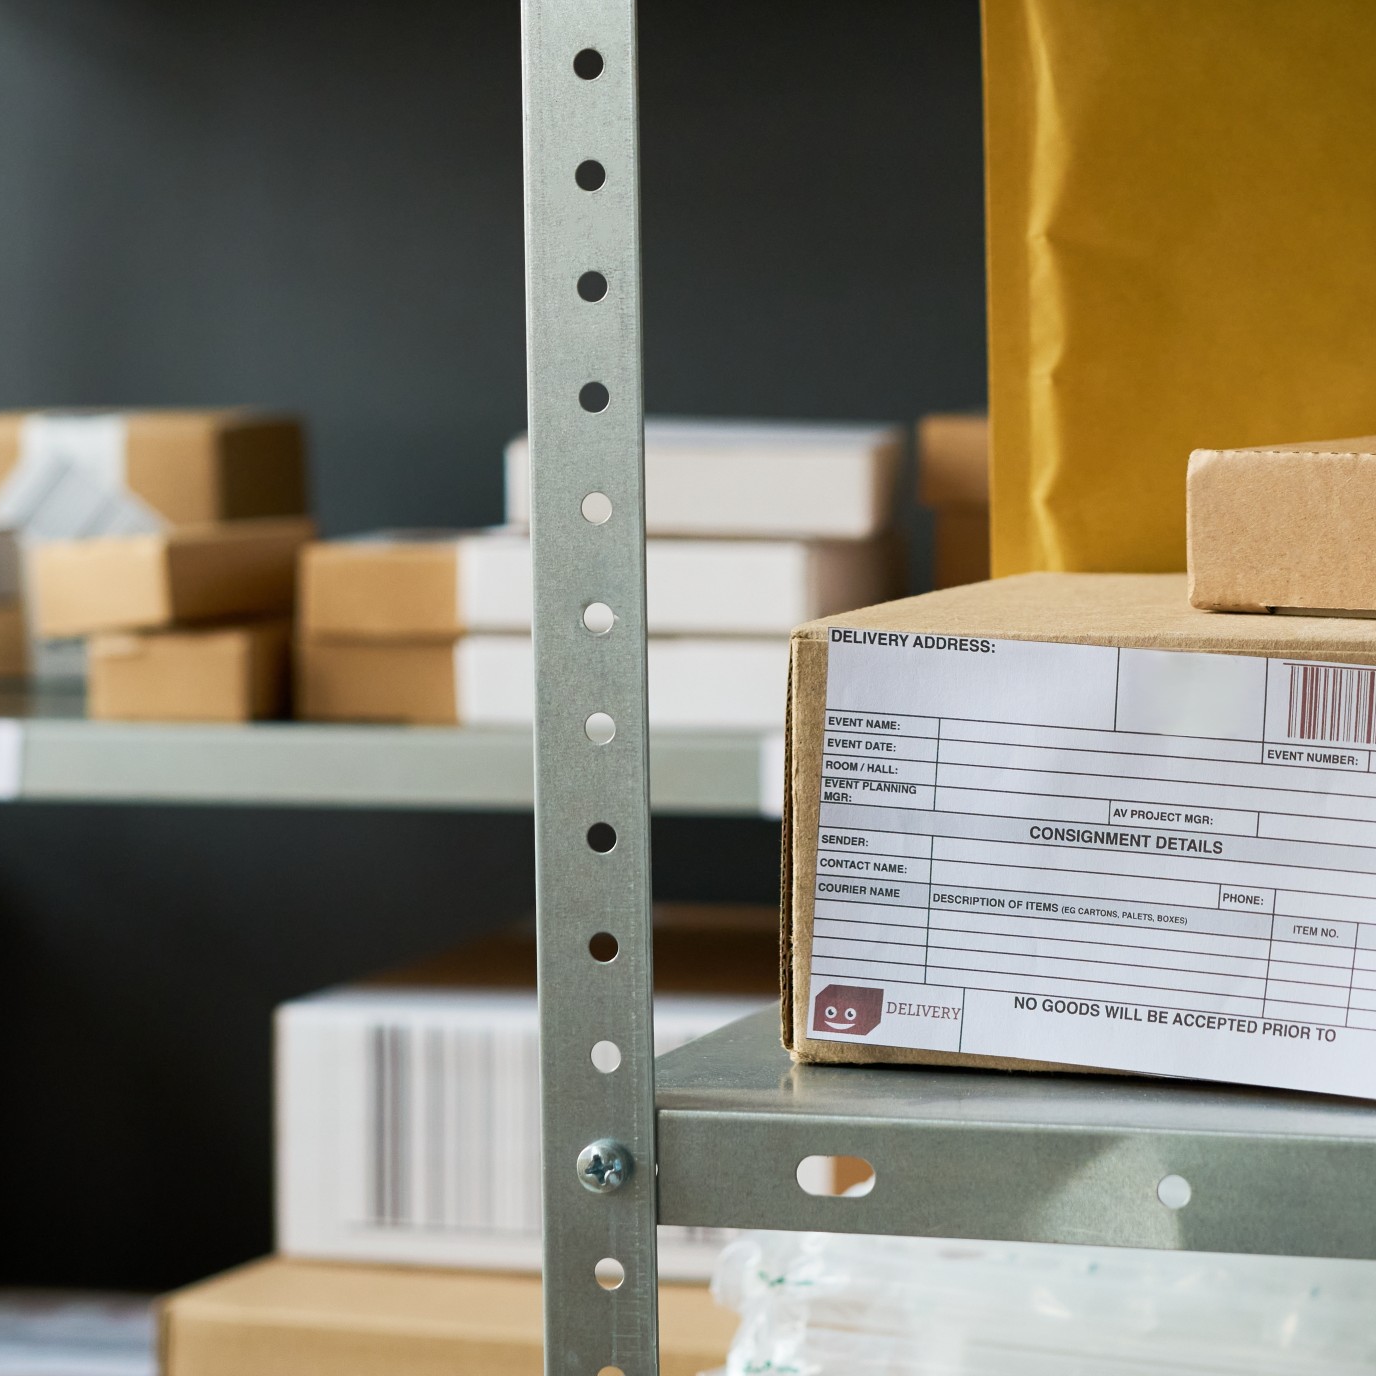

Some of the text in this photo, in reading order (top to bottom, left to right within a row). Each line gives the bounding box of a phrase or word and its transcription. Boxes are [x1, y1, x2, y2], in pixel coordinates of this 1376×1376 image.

[831, 629, 996, 653] DELIVERY ADDRESS:
[828, 716, 901, 730] EVENT NAME:
[827, 738, 896, 752] EVENT DATE:
[1267, 749, 1359, 766] EVENT NUMBER:
[826, 760, 858, 772] ROOM
[867, 764, 898, 774] HALL:
[824, 778, 917, 794] EVENT PLANNING
[824, 792, 852, 802] MGR:
[1113, 808, 1214, 825] AV PROJECT MGR:
[821, 834, 869, 846] SENDER:
[1029, 825, 1224, 854] CONSIGNMENT DETAILS
[820, 858, 907, 874] CONTACT NAME:
[818, 883, 900, 898] COURIER NAME
[1223, 893, 1264, 905] PHONE:
[933, 893, 1188, 925] DESCRIPTION OF ITEMS (EG CARTONS, PALETS, BOXES)
[1293, 925, 1339, 939] ITEM NO.
[886, 1002, 962, 1020] DELIVERY
[1014, 996, 1337, 1043] NO GOODS WILL BE ACCEPTED PRIOR TO
